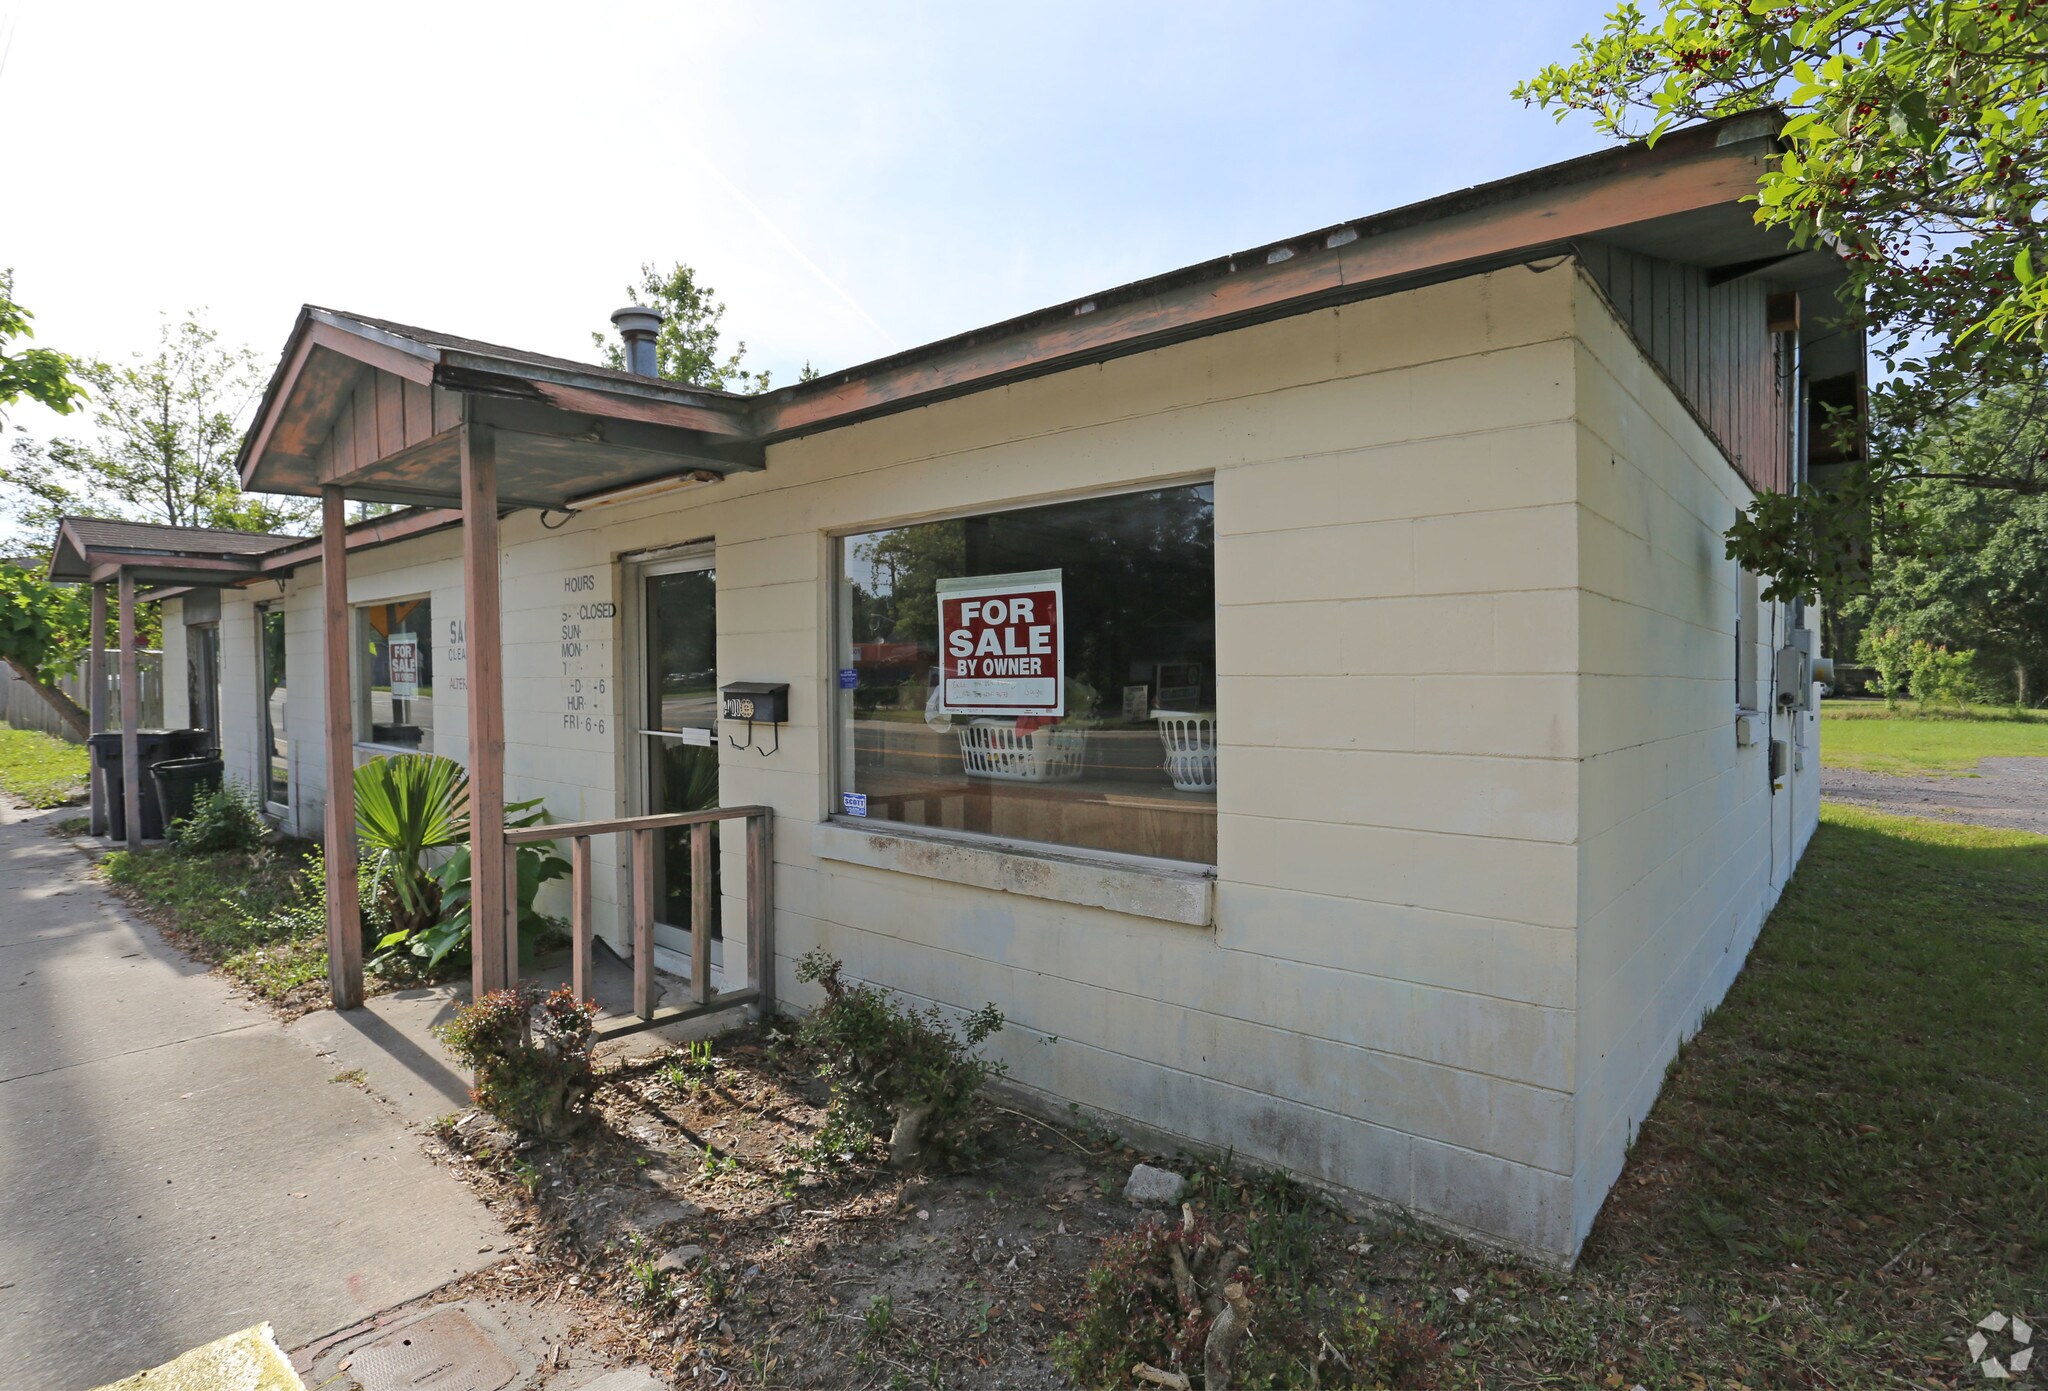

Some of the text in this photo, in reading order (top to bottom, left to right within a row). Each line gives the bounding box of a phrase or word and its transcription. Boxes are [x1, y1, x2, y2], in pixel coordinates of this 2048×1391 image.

[564, 575, 595, 592] HOURS
[580, 602, 616, 620] CLOSED
[961, 598, 1034, 627] FOR
[450, 619, 466, 644] SA
[949, 625, 1051, 657] SALE
[394, 645, 412, 658] FOR
[448, 647, 466, 661] CLEA
[392, 658, 416, 673] SALE
[957, 657, 1042, 676] BY OWNER
[449, 677, 468, 690] ALTER
[845, 798, 864, 806] SCOTT
